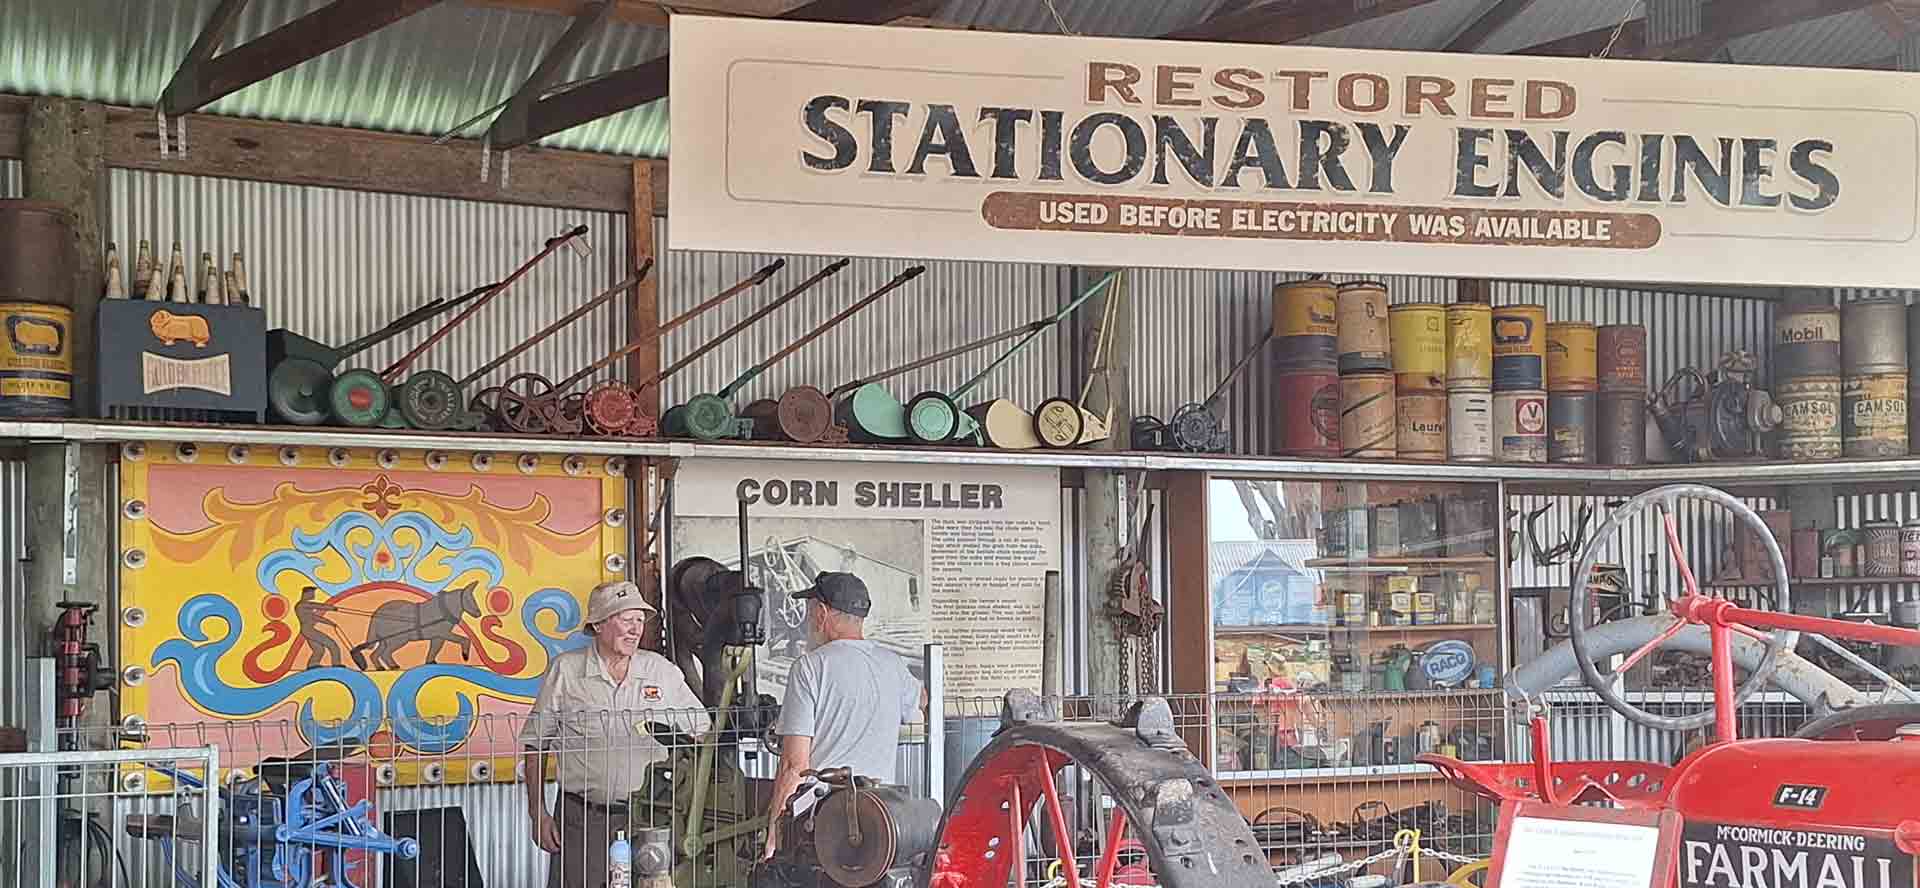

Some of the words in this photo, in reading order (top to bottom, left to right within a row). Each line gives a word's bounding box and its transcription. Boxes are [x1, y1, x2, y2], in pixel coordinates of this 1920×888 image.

[1086, 60, 1577, 120] RESTORED
[801, 94, 1412, 195] STATIONARY
[1453, 125, 1841, 210] ENGINES
[1039, 201, 1109, 225] USED
[1119, 203, 1221, 230] BEFORE
[1231, 208, 1399, 235] ELECTRICITY
[1408, 213, 1466, 238] WAS
[1474, 215, 1612, 242] AVAILABLE
[1782, 327, 1823, 342] Mobil
[1784, 401, 1834, 417] CAMSOL
[1856, 399, 1906, 415] CAMSOL
[736, 478, 839, 506] CORN
[854, 481, 1004, 509] SHELLER
[1778, 786, 1818, 806] F-14
